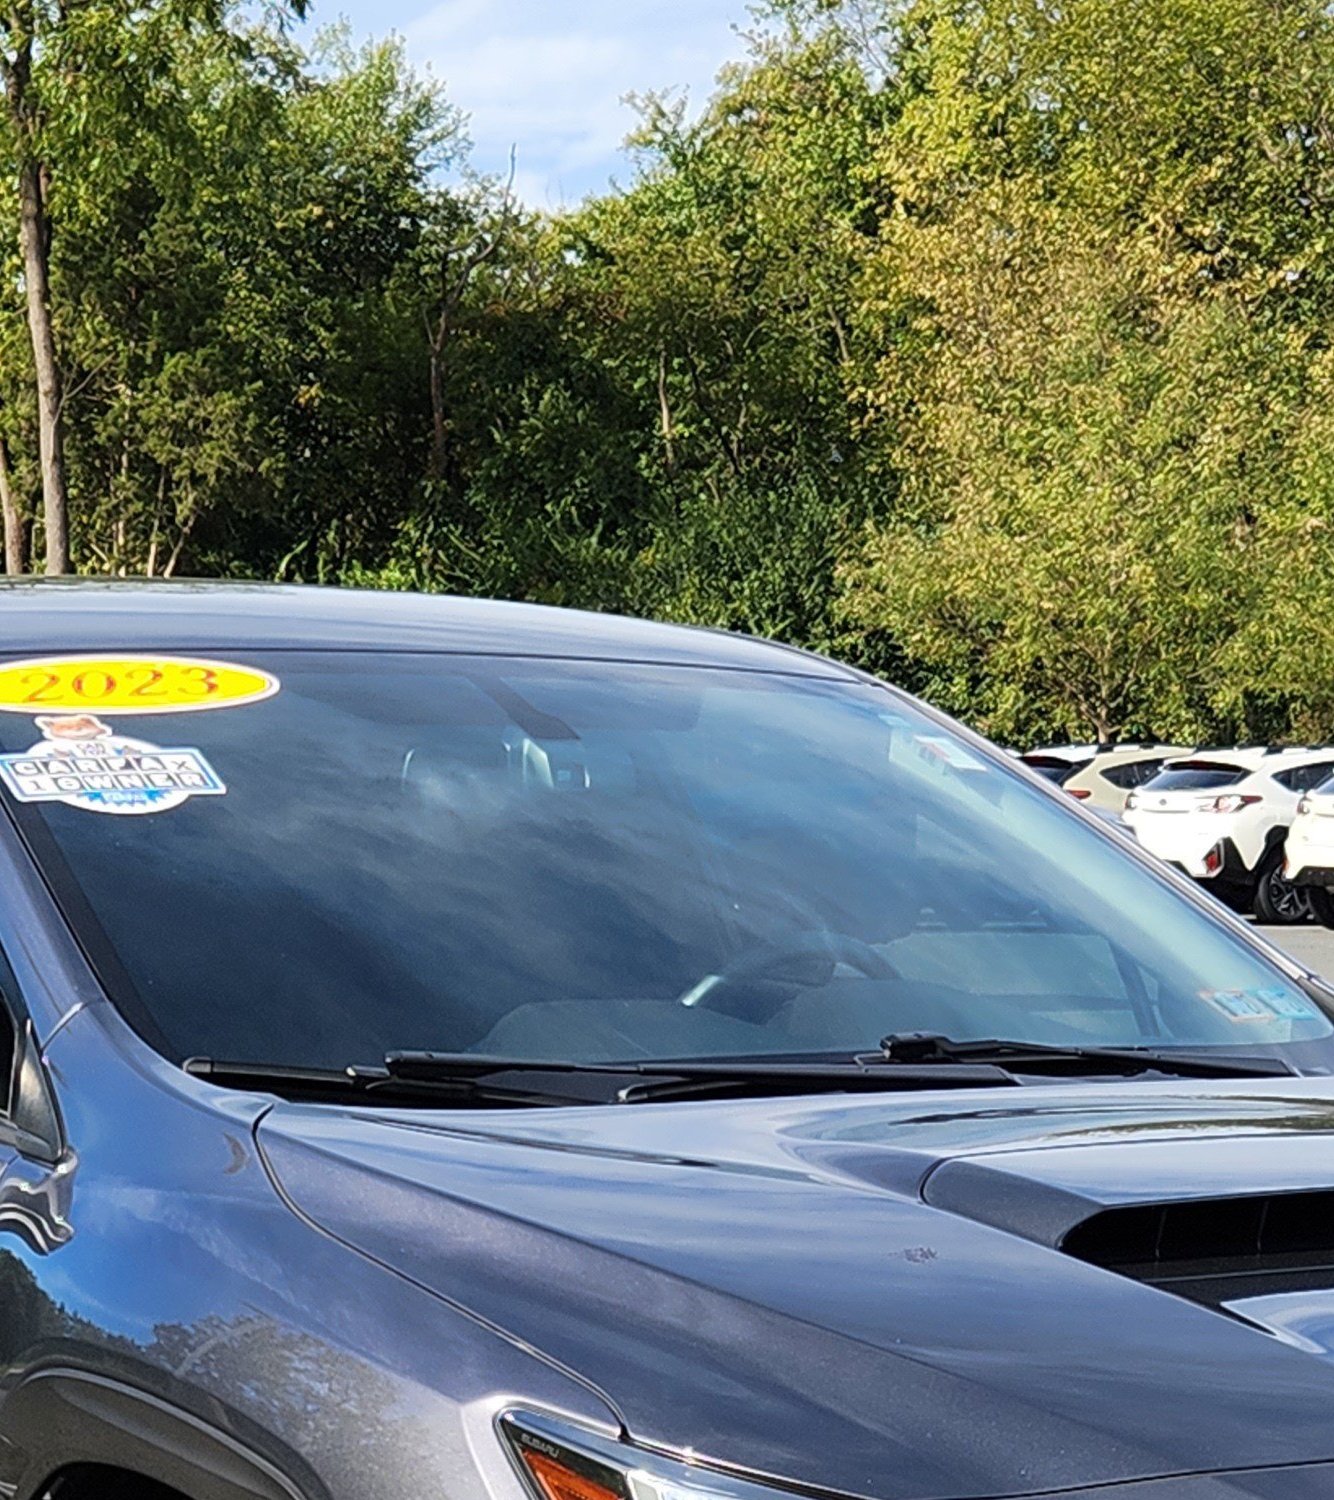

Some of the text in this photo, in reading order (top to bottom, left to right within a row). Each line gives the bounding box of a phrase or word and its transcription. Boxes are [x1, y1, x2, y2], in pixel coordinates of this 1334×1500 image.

[21, 668, 219, 703] 2023
[10, 757, 193, 777] CARFAX
[27, 773, 208, 792] 1 OWNER
